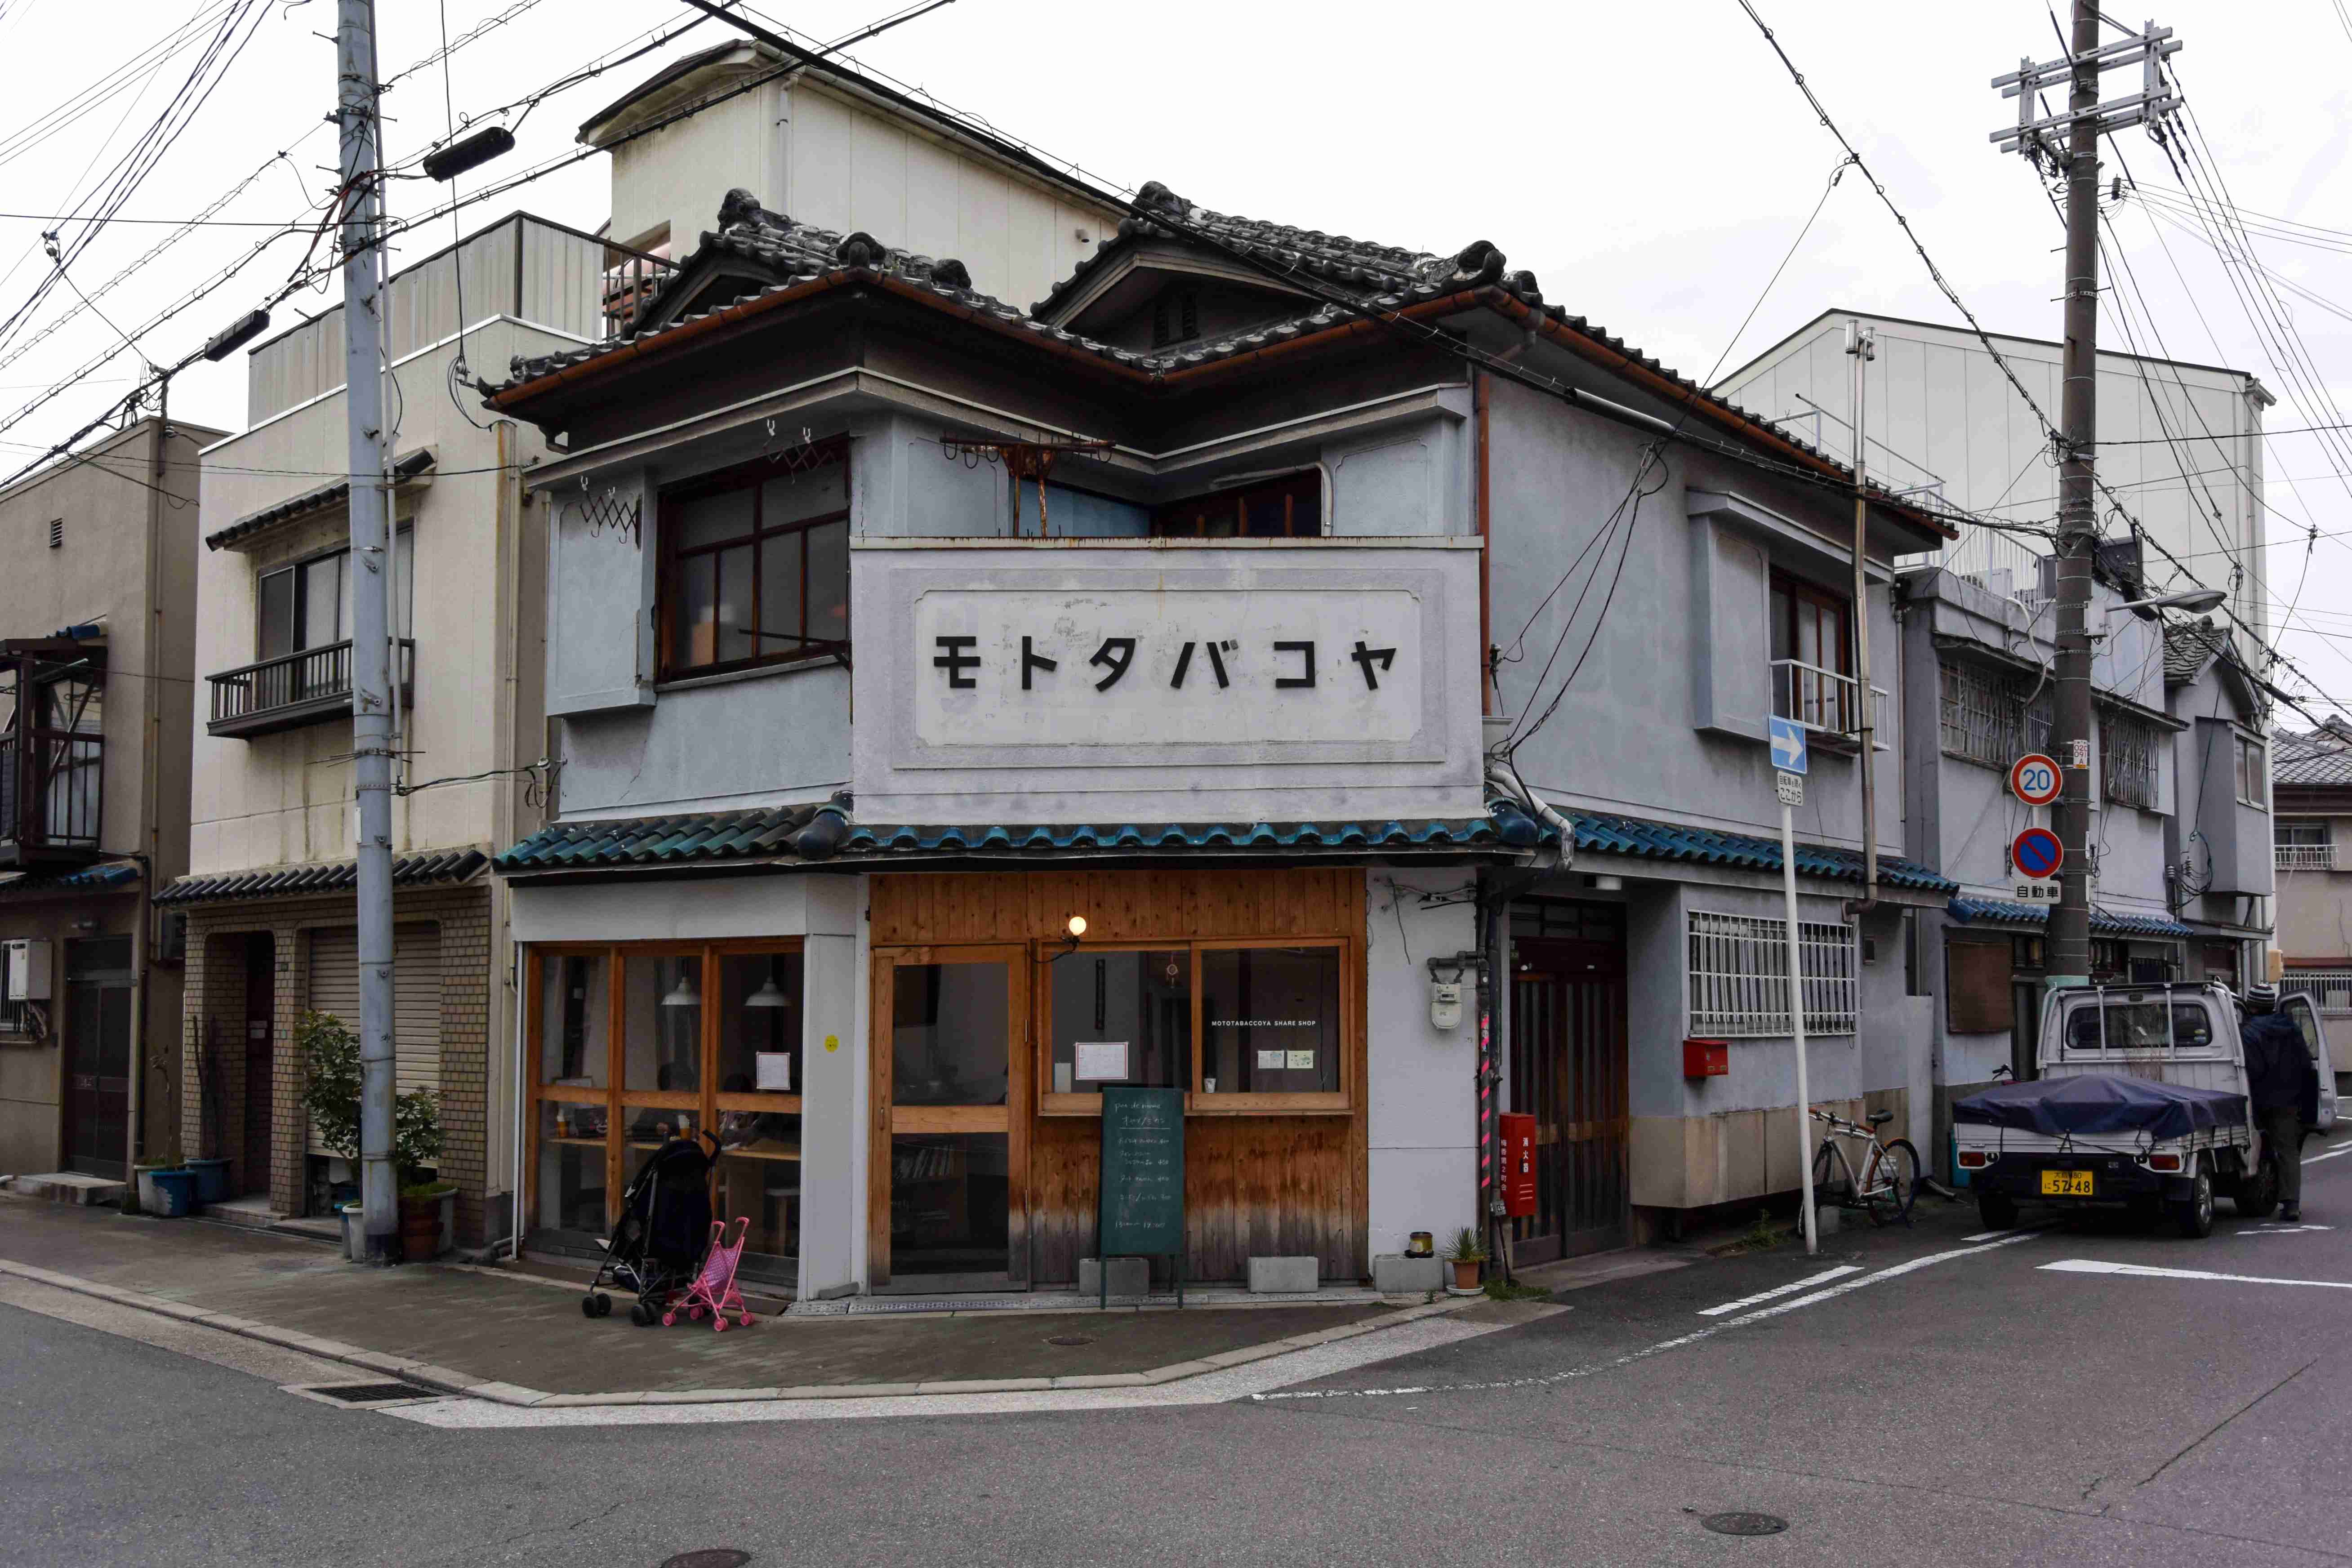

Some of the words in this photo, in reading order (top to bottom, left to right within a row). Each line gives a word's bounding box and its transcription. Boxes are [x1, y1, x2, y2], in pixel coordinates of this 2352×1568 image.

[933, 635, 1397, 692] モトタバコヤ
[2023, 769, 2050, 791] 20
[1780, 788, 1802, 804] ここから
[2017, 885, 2058, 898] 自動車
[2053, 1180, 2090, 1193] 57-48
